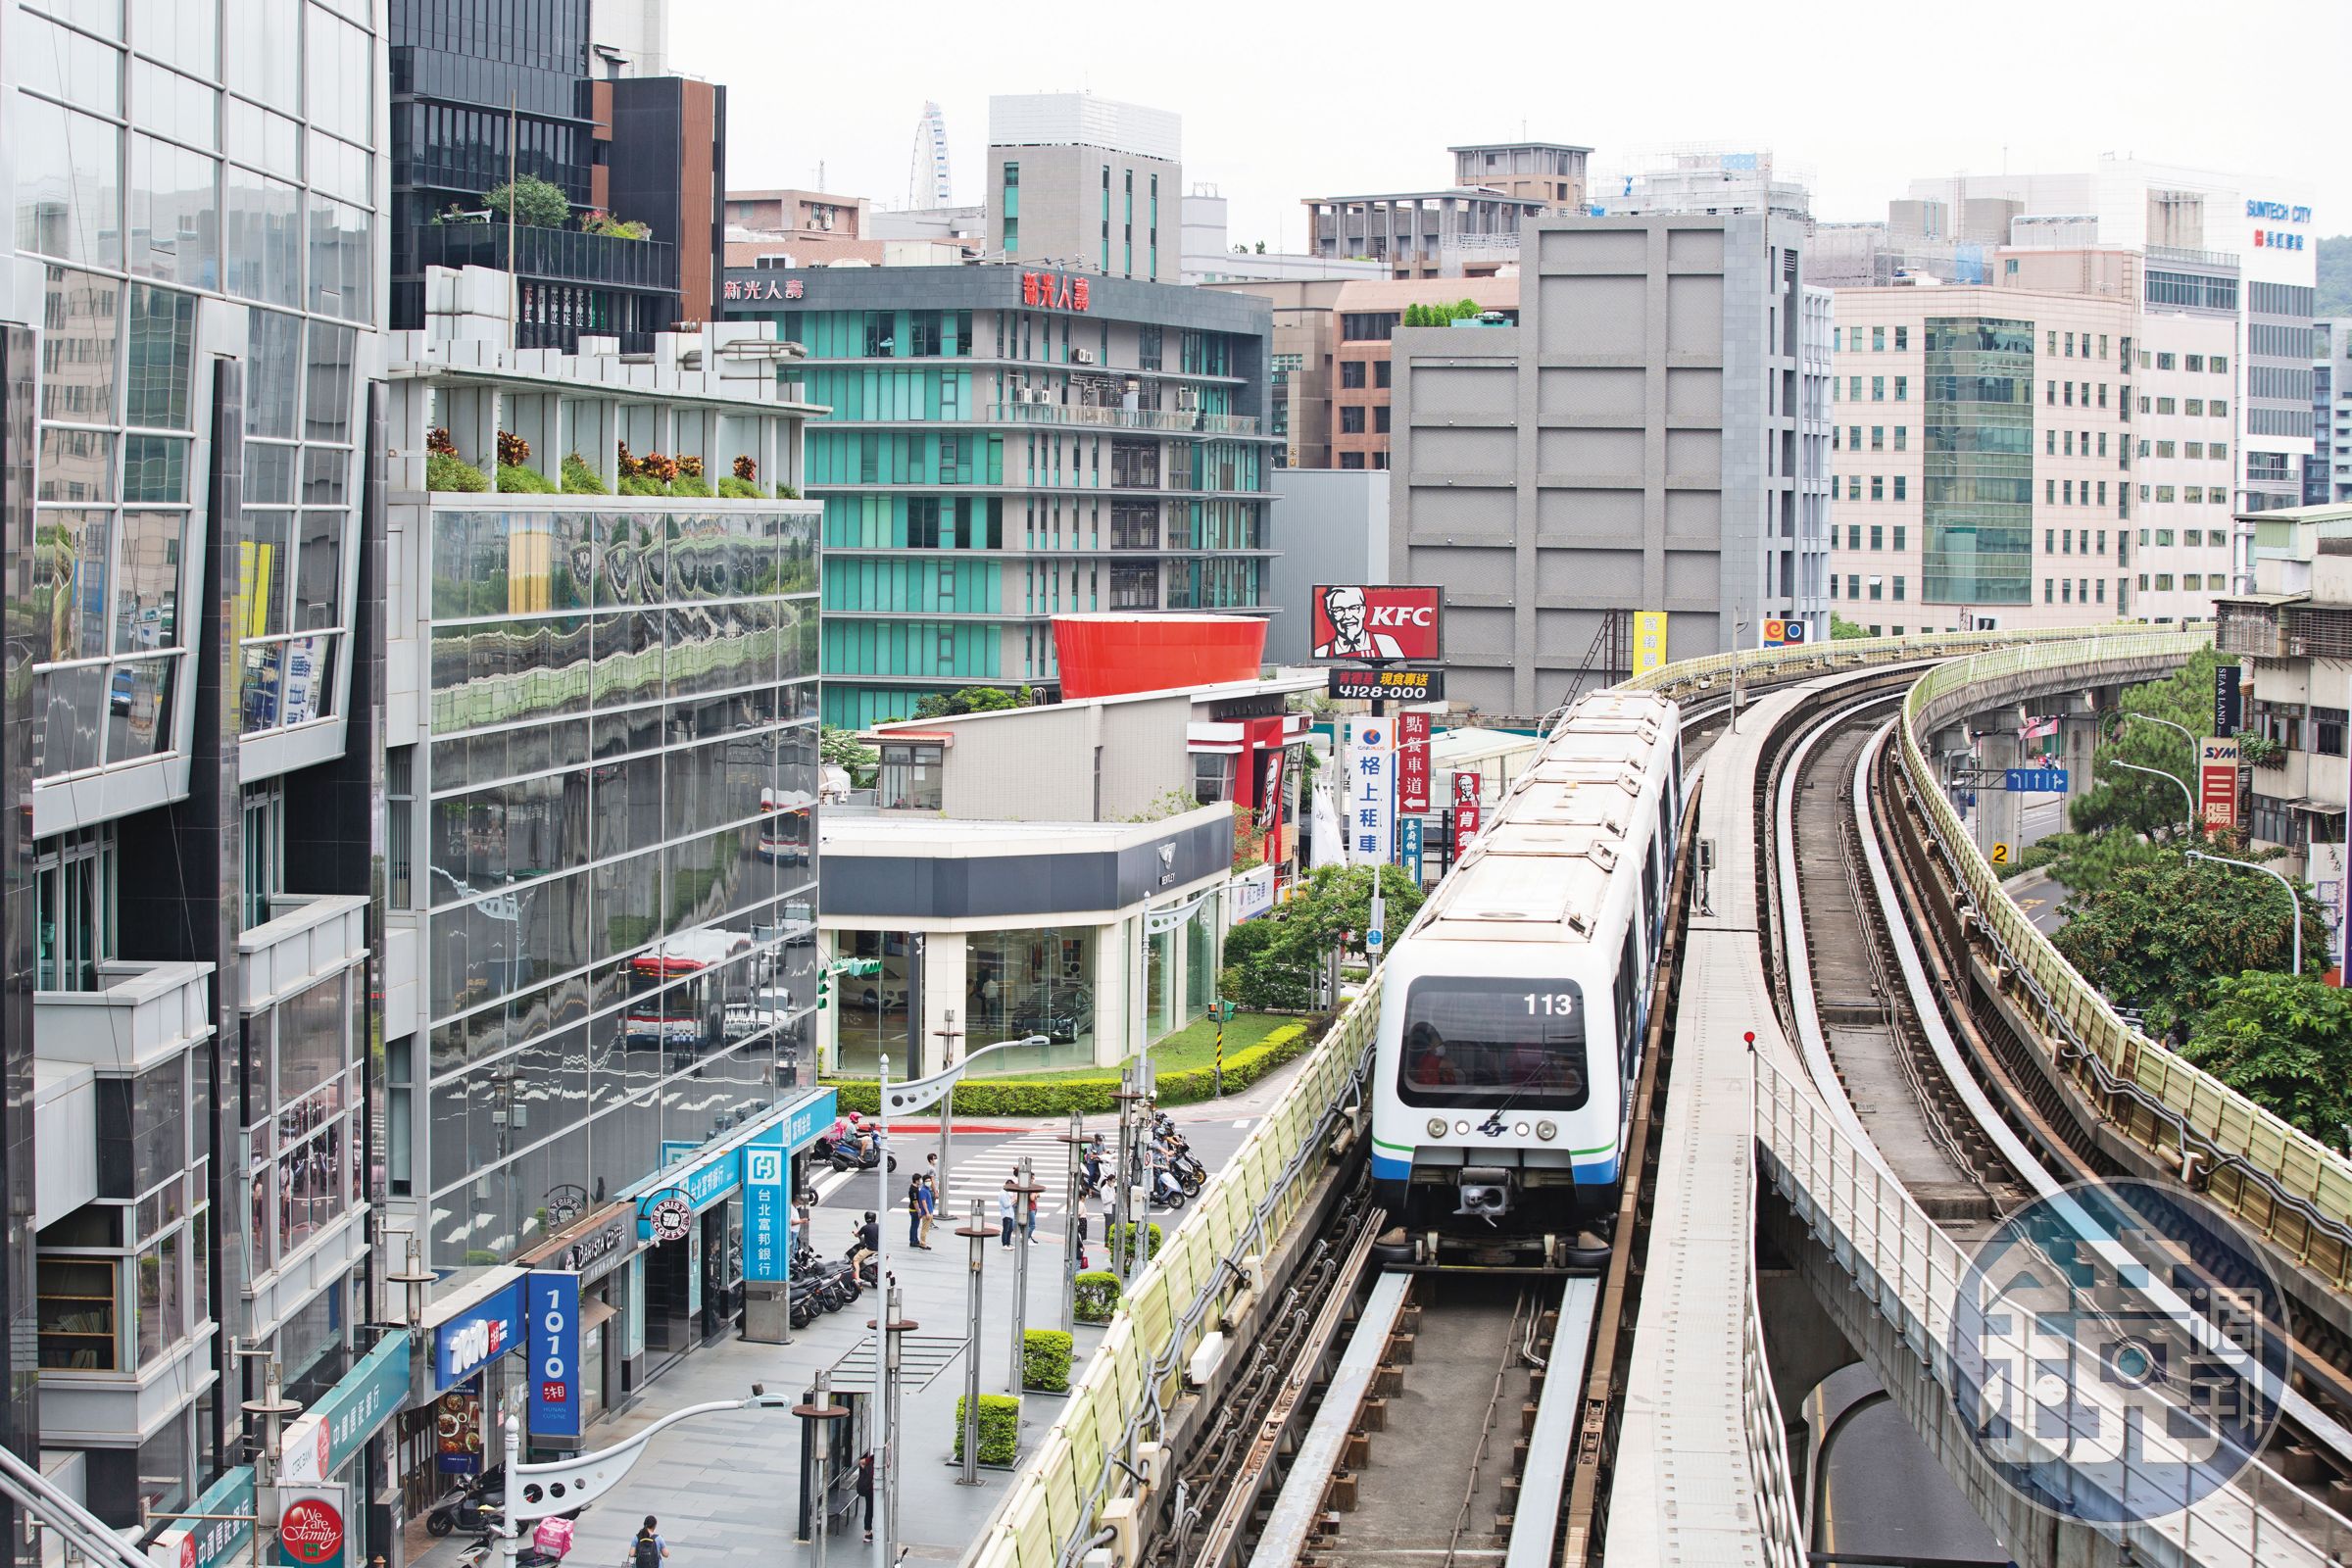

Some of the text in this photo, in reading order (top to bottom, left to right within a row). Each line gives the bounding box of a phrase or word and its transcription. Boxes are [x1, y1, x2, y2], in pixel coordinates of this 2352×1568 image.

[2247, 199, 2311, 223] SUNTECH CITY
[2266, 231, 2303, 251] 長虹建設
[724, 279, 804, 300] 新光人壽
[1023, 271, 1089, 311] 新光人壽
[1369, 606, 1432, 627] KFC
[1379, 673, 1429, 686] 現食專送
[2218, 667, 2227, 686] SEA
[1338, 685, 1427, 699] 4128-000
[2217, 697, 2227, 725] LAND
[1405, 715, 1423, 795] 點餐車道
[2205, 746, 2237, 760] SYM
[1358, 756, 1381, 854] 格上租車
[1458, 810, 1475, 855] 肯德
[1993, 845, 2007, 862] 2
[1523, 993, 1572, 1015] 113
[653, 1201, 689, 1219] BARISTA
[653, 1221, 689, 1239] COFFEE
[758, 1189, 771, 1276] 台北富邦銀行
[578, 1236, 605, 1268] BARISTA
[606, 1224, 625, 1250] COFFEE
[545, 1289, 564, 1379] 1010
[450, 1319, 489, 1374] 1010
[333, 1383, 379, 1449] 中國信託銀行
[302, 1508, 322, 1521] We
[311, 1519, 328, 1530] are
[198, 1497, 249, 1567] 中國信託銀行
[282, 1520, 343, 1549] Family
